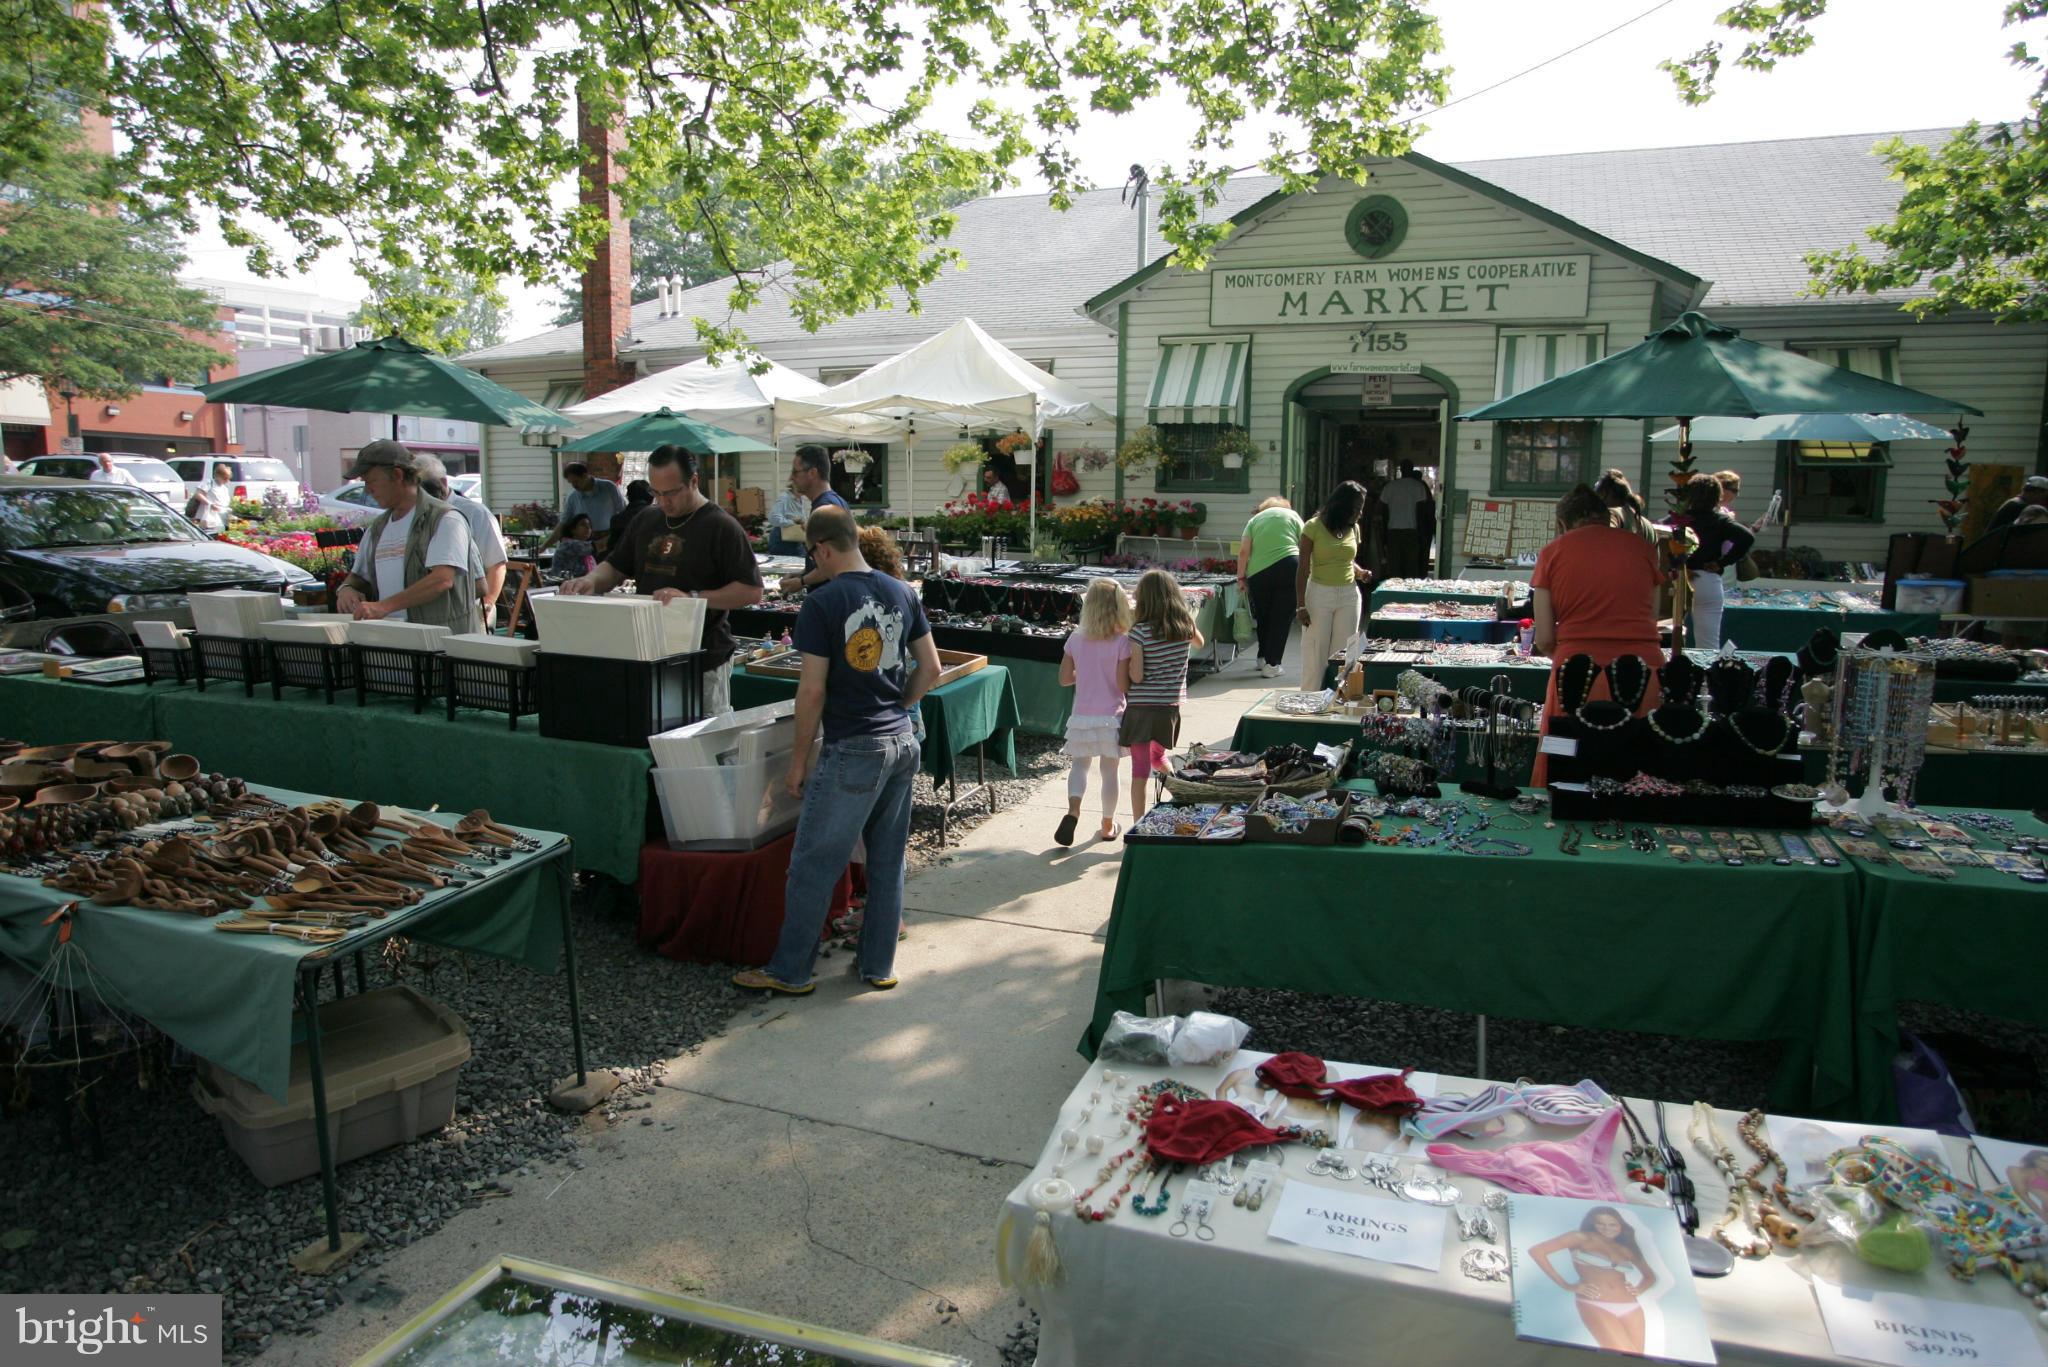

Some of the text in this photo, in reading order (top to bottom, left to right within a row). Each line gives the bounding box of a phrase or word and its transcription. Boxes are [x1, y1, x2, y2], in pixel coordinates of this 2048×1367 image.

[1225, 262, 1577, 288] MONTGOMERY FARM WOMENS COOPERATIVE
[1278, 284, 1510, 316] MARKET
[1306, 1208, 1408, 1233] EARRINGS
[1326, 1224, 1381, 1242] $25.00
[1874, 1320, 1975, 1343] BIKINIS
[1905, 1340, 1979, 1358] $49.99
